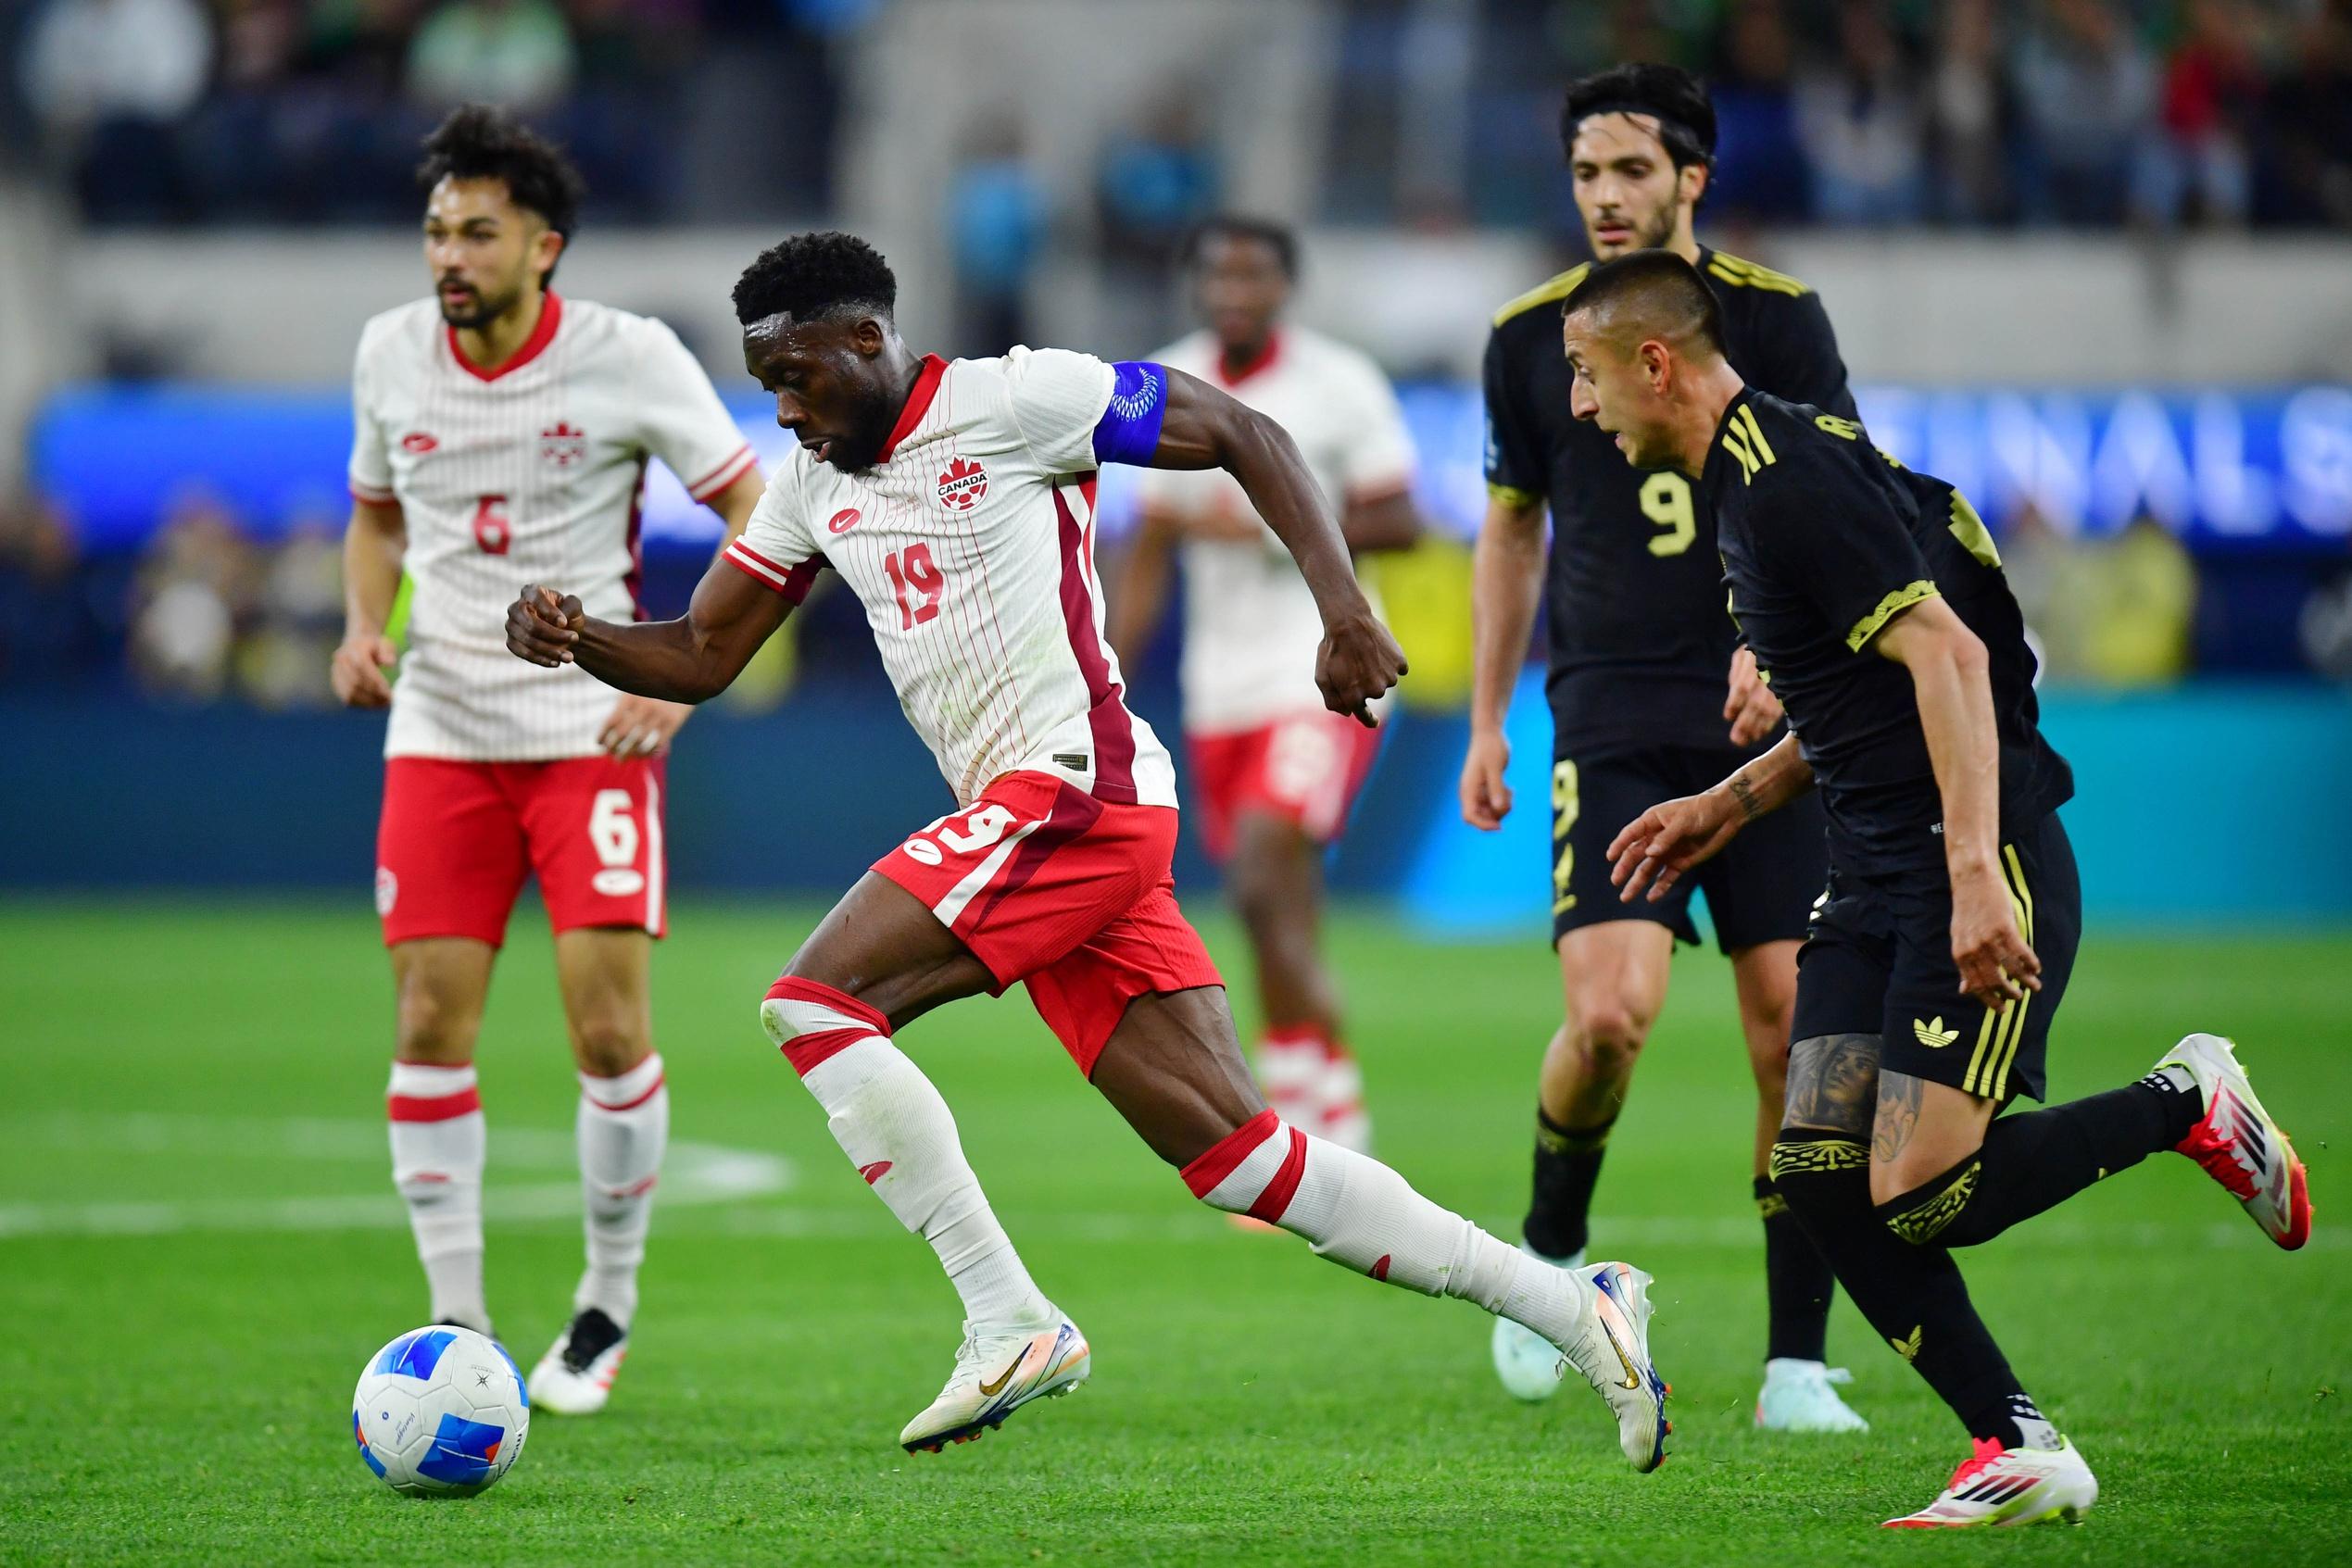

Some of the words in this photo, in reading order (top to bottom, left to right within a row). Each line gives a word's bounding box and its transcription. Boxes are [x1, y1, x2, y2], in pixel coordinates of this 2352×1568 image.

[473, 494, 511, 556] 6
[937, 473, 987, 496] CANADA
[1638, 470, 1697, 558] 9
[885, 541, 945, 631] 19
[588, 788, 639, 868] 6
[1552, 759, 1580, 842] 9
